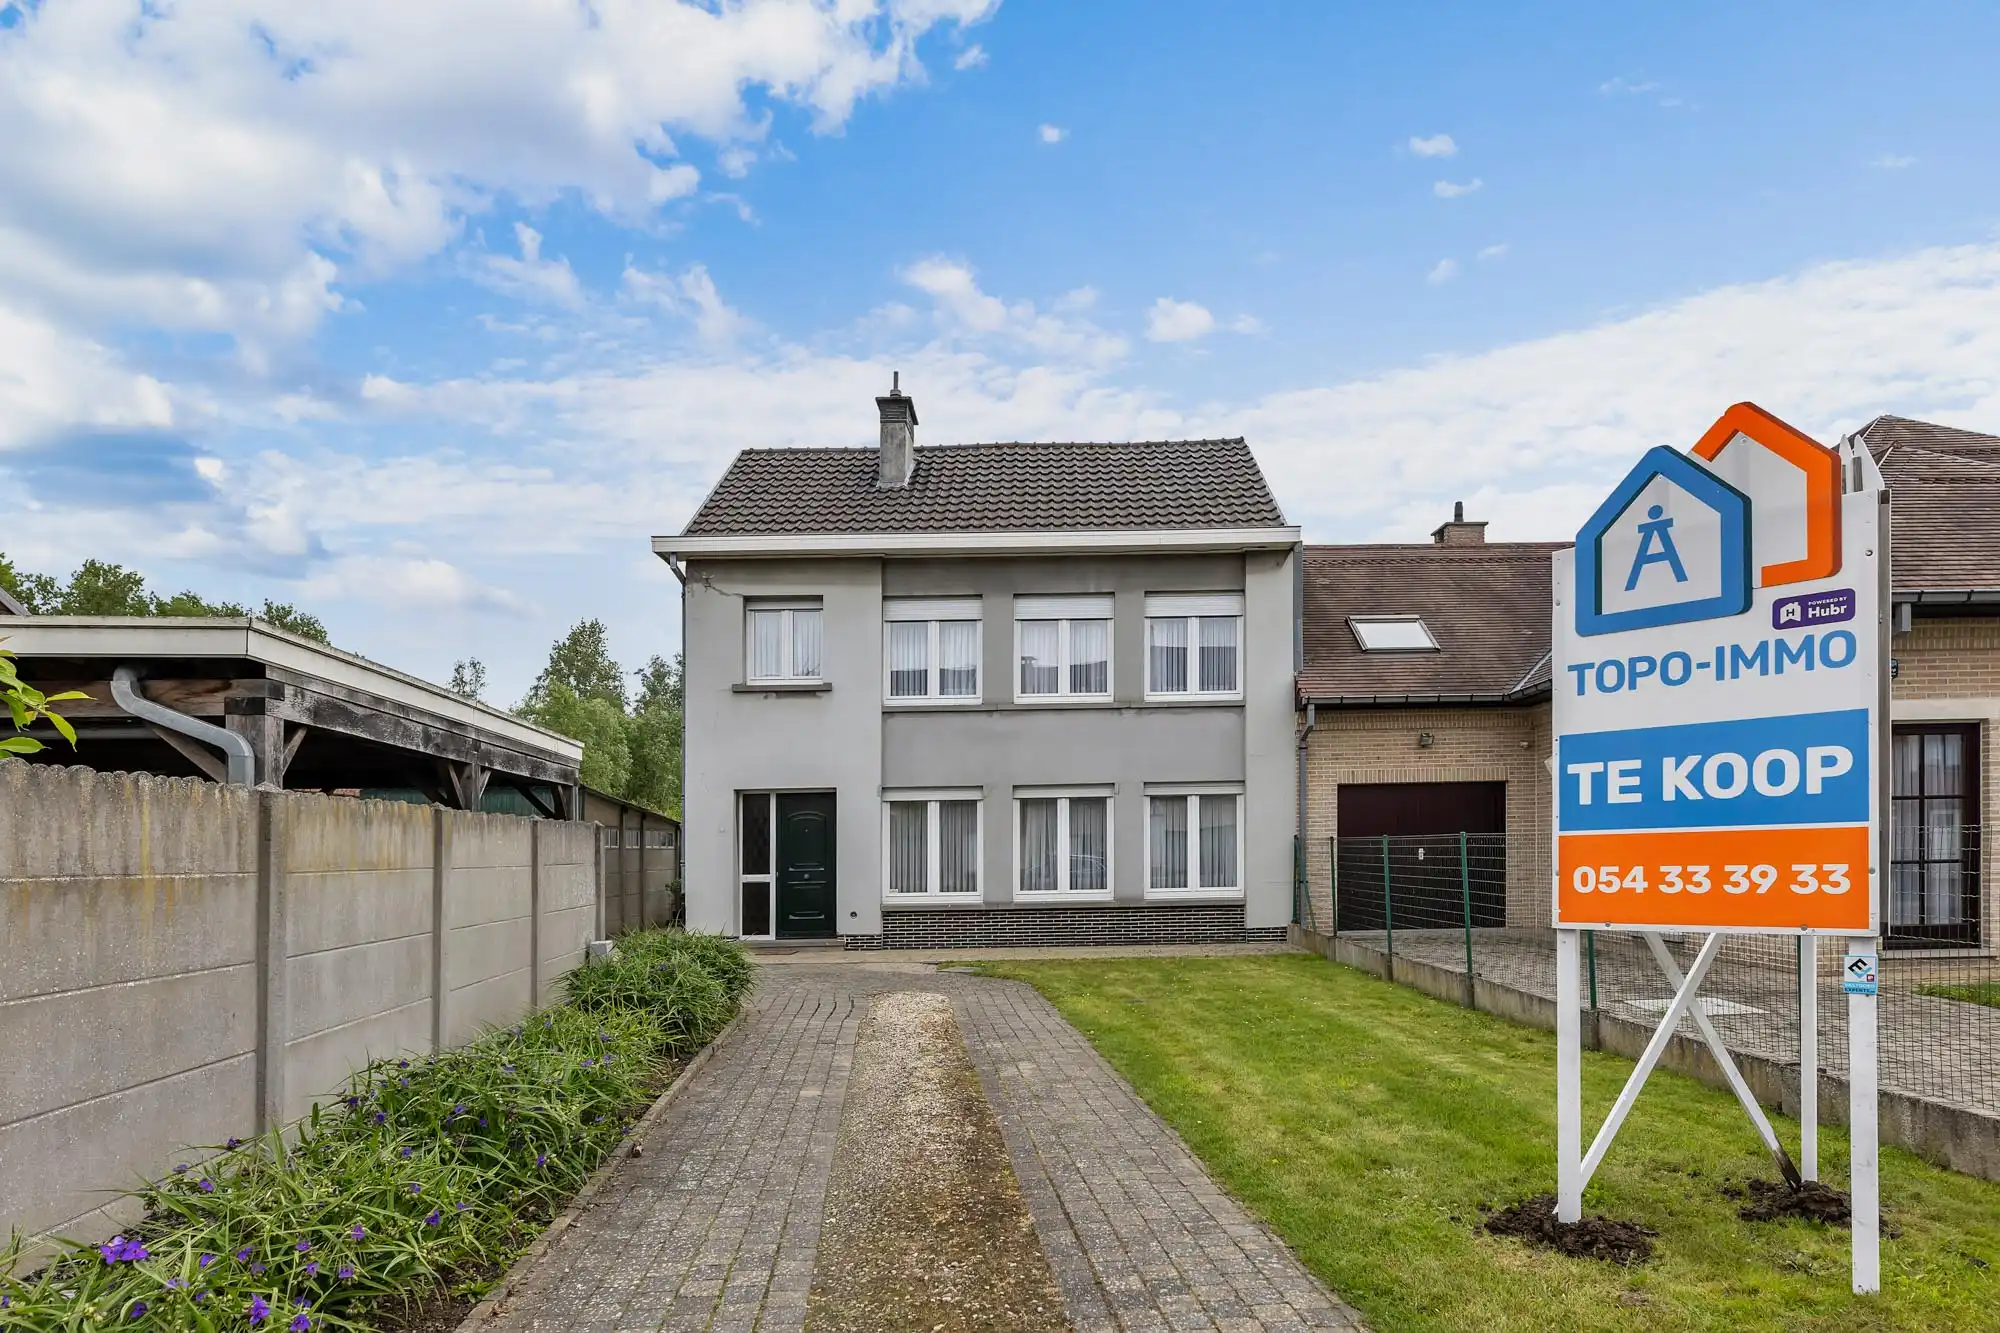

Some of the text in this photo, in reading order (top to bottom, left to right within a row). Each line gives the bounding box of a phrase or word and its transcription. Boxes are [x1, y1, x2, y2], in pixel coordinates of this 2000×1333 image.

[1808, 598, 1838, 606] POWERED
[1808, 604, 1847, 618] Hubr
[1567, 629, 1857, 696] TOPO-IMMO
[1567, 745, 1853, 805] TE KOOP
[1573, 863, 1851, 895] 054 33 39 33
